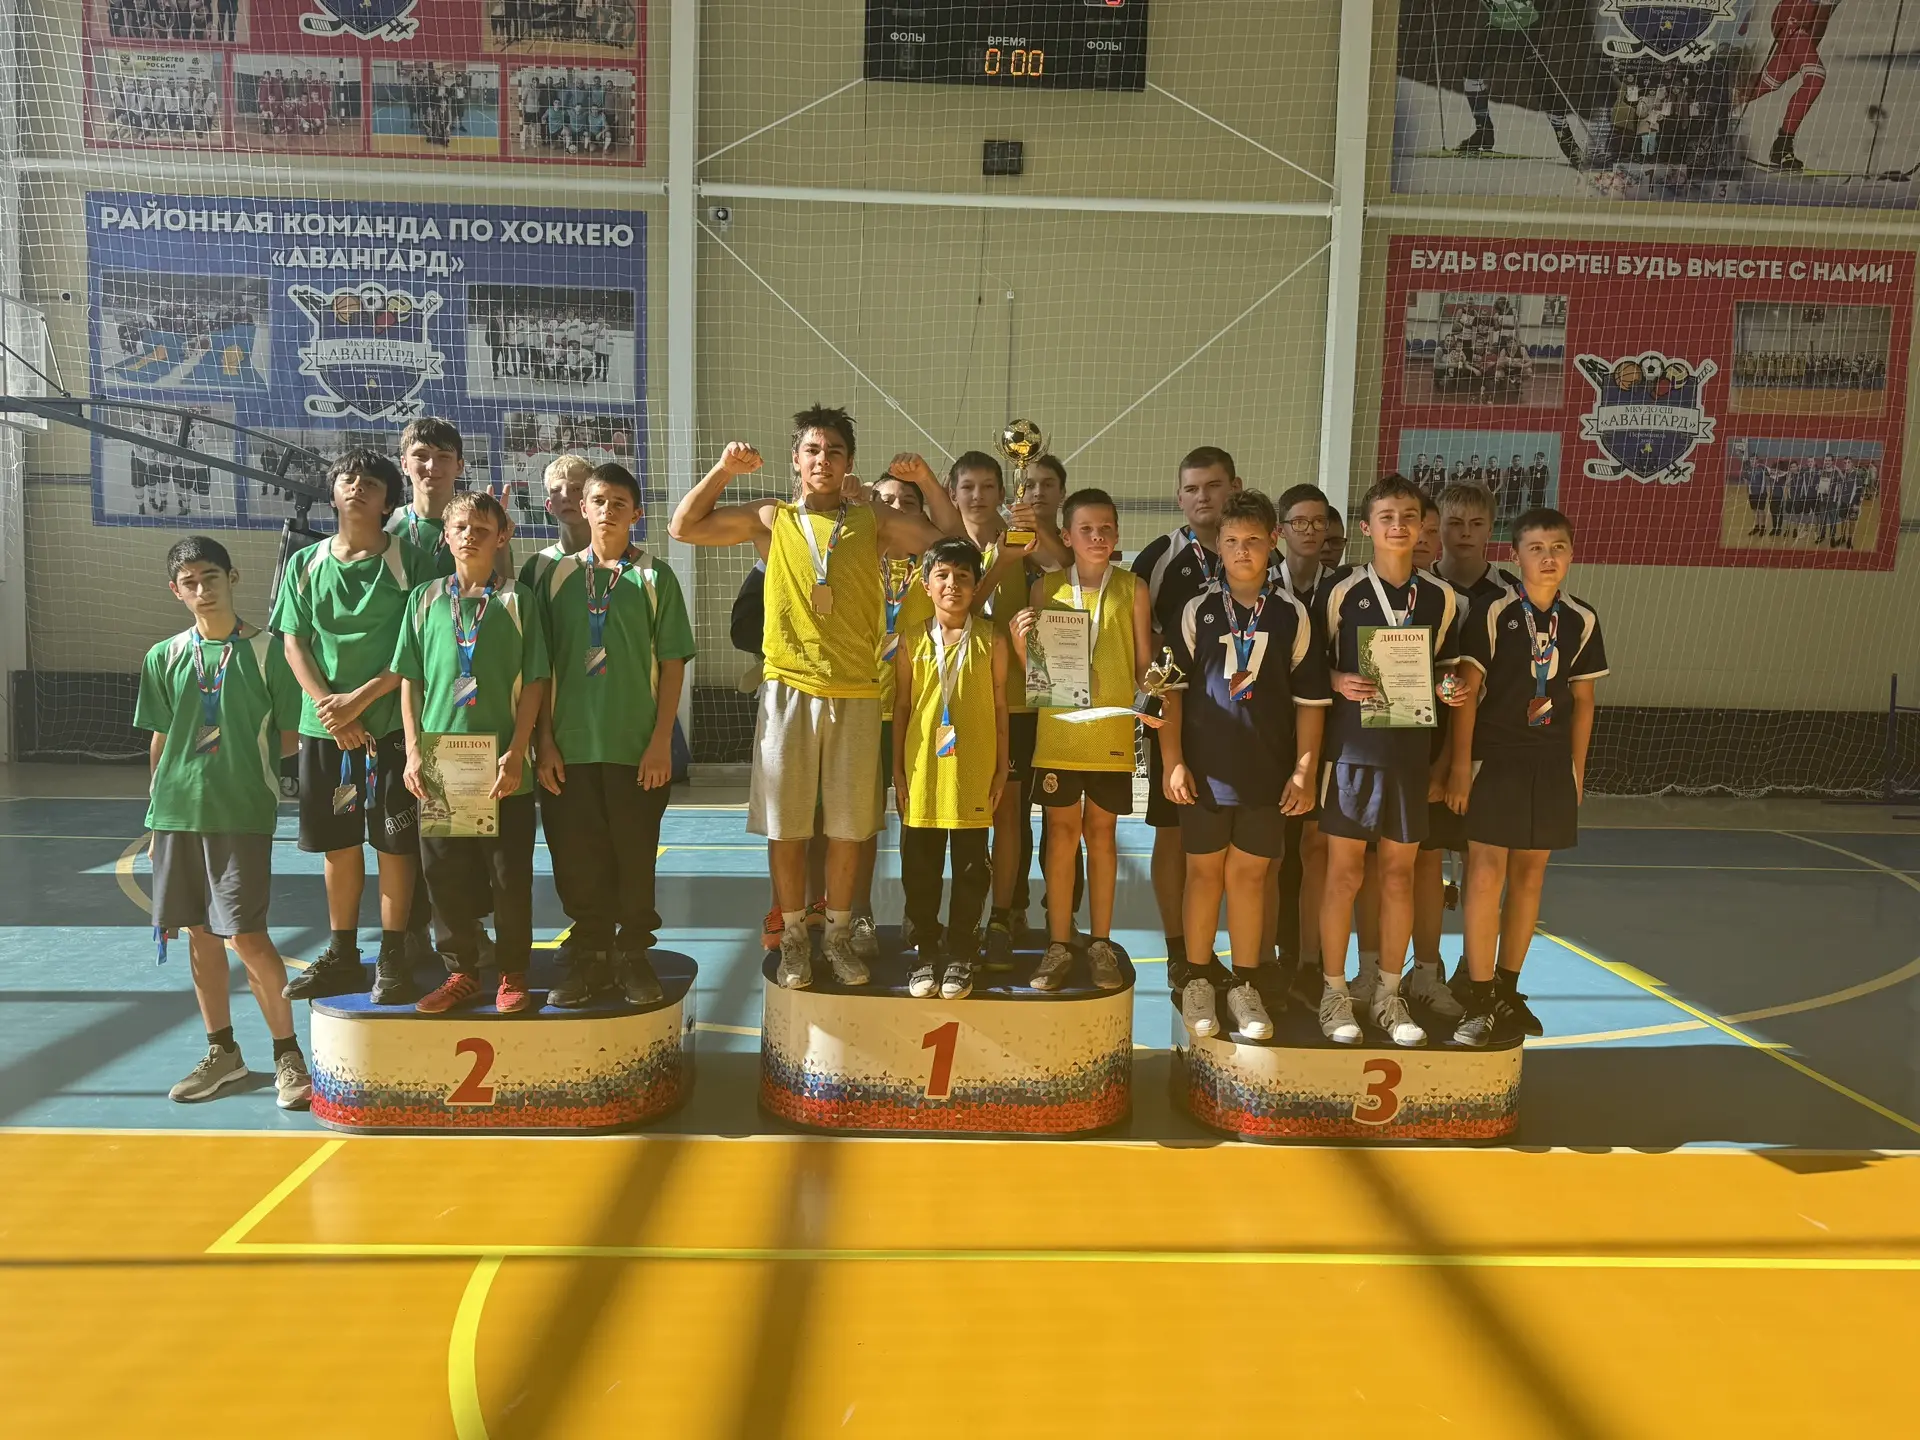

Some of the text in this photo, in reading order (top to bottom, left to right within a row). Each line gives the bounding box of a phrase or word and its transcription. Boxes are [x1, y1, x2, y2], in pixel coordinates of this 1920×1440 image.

[890, 32, 926, 42] ФОЛЫ
[987, 36, 1026, 47] ВРЕМЯ
[1086, 40, 1122, 51] ФОЛЫ
[137, 55, 185, 63] ПЕРВЕНСТВО
[100, 200, 634, 248] РАЙОННАЯ КОМАНДА ПО ХОККЕЮ
[271, 245, 465, 277] «АВАНГАРД»
[1410, 250, 1893, 284] БУДЬ В СПОРТЕ! БУДЬ ВМЕСТЕ С НАМИ!
[1644, 406, 1658, 414] ДО
[1601, 413, 1696, 432] «АВАНГАРД»
[1046, 615, 1084, 625] ДИПЛОМ
[1380, 634, 1424, 643] ДИПЛОМ
[1218, 630, 1270, 681] 17
[445, 740, 491, 749] ДИПЛОМ
[921, 1021, 960, 1096] 1
[445, 1037, 495, 1103] 2
[1354, 1058, 1402, 1123] 3
